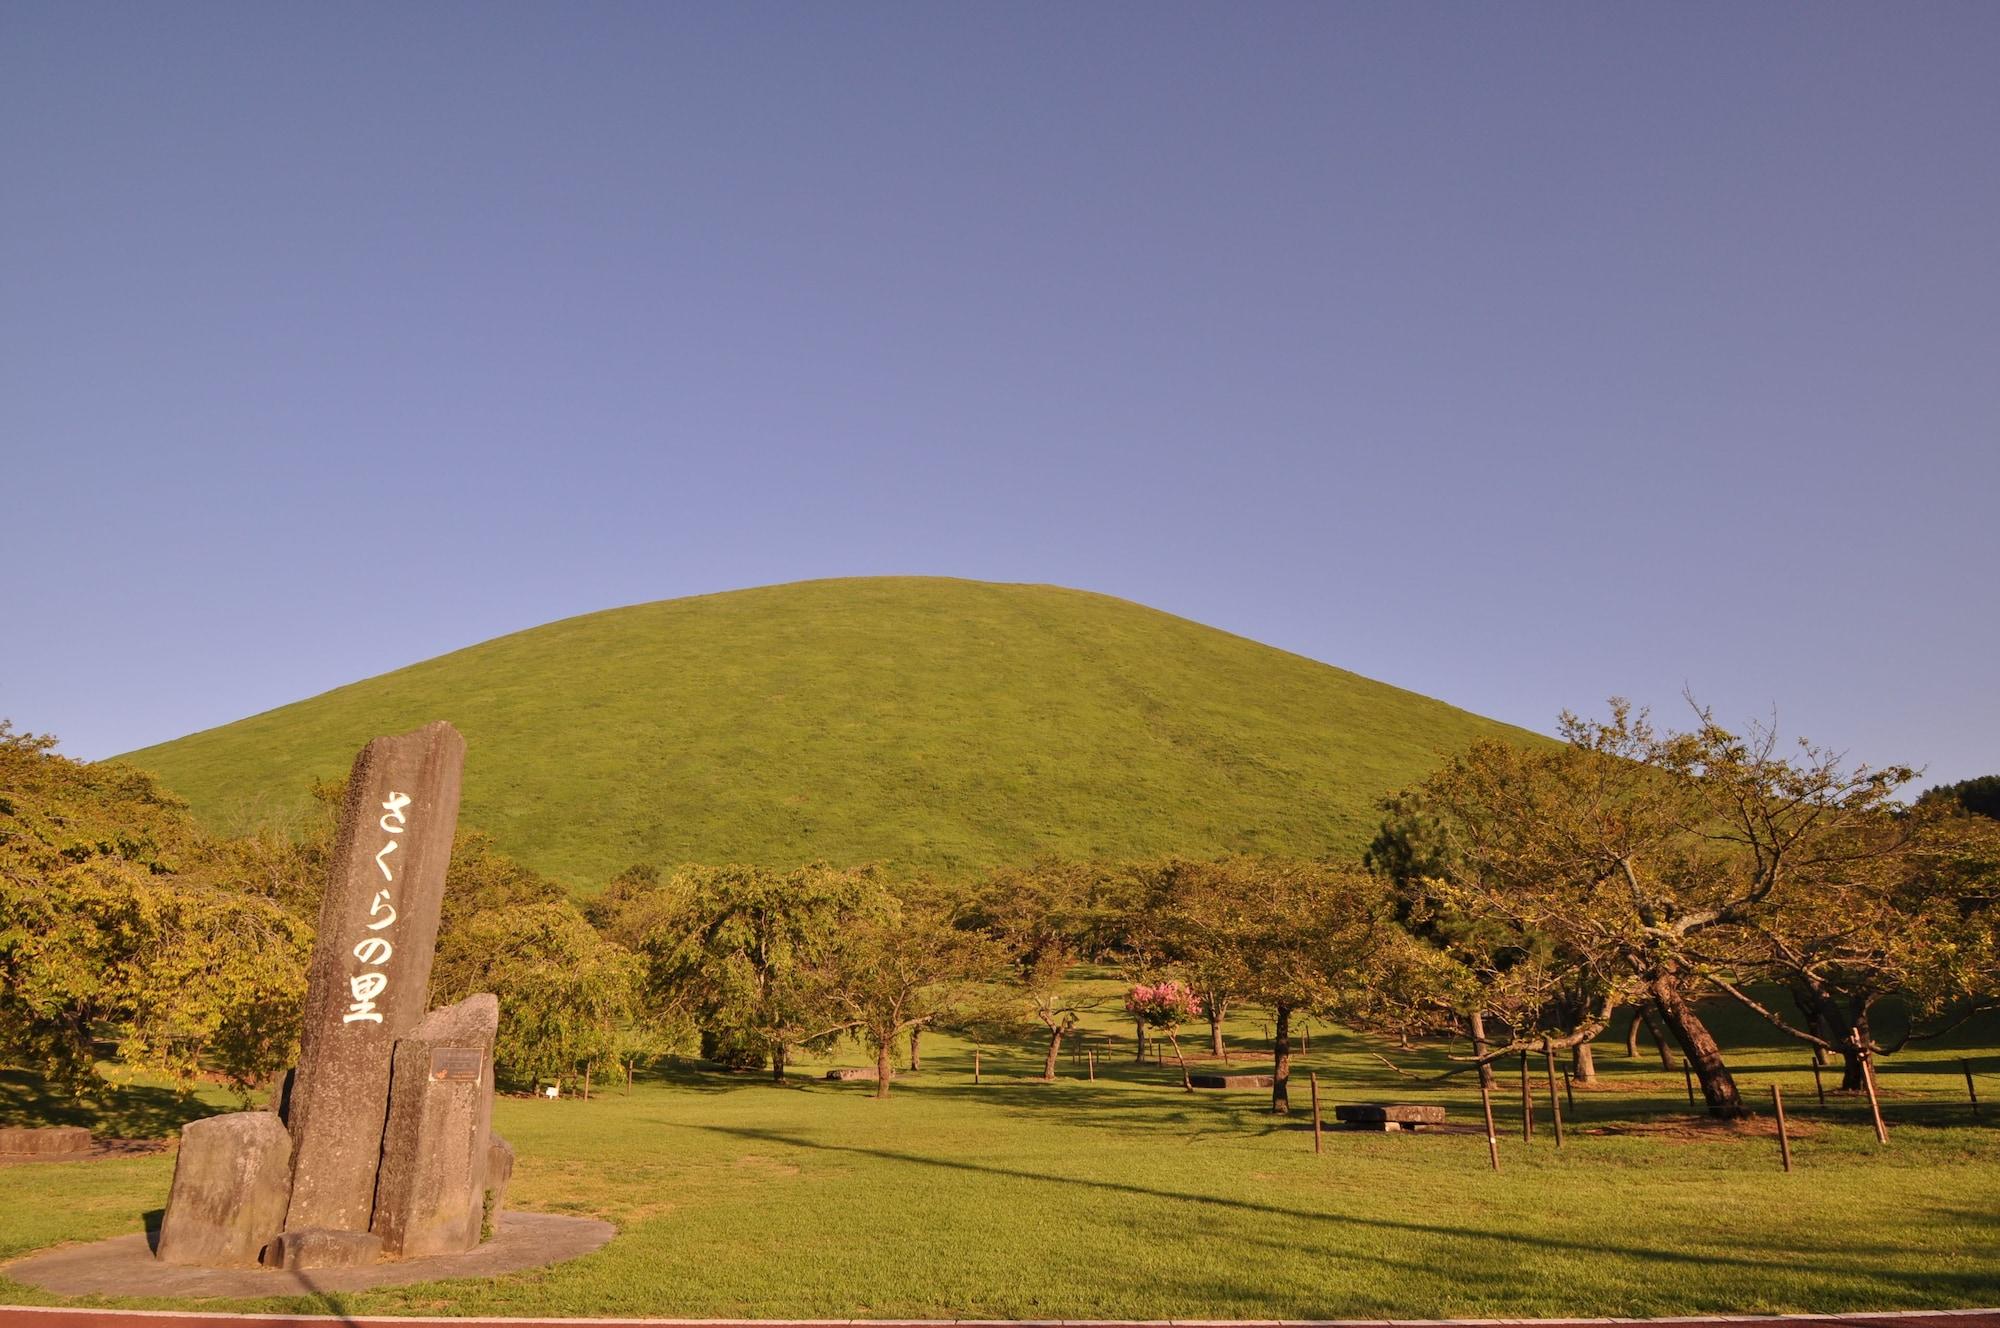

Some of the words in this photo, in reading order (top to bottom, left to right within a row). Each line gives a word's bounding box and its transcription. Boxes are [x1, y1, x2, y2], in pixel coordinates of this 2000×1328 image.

[343, 791, 412, 1024] さくらの里
